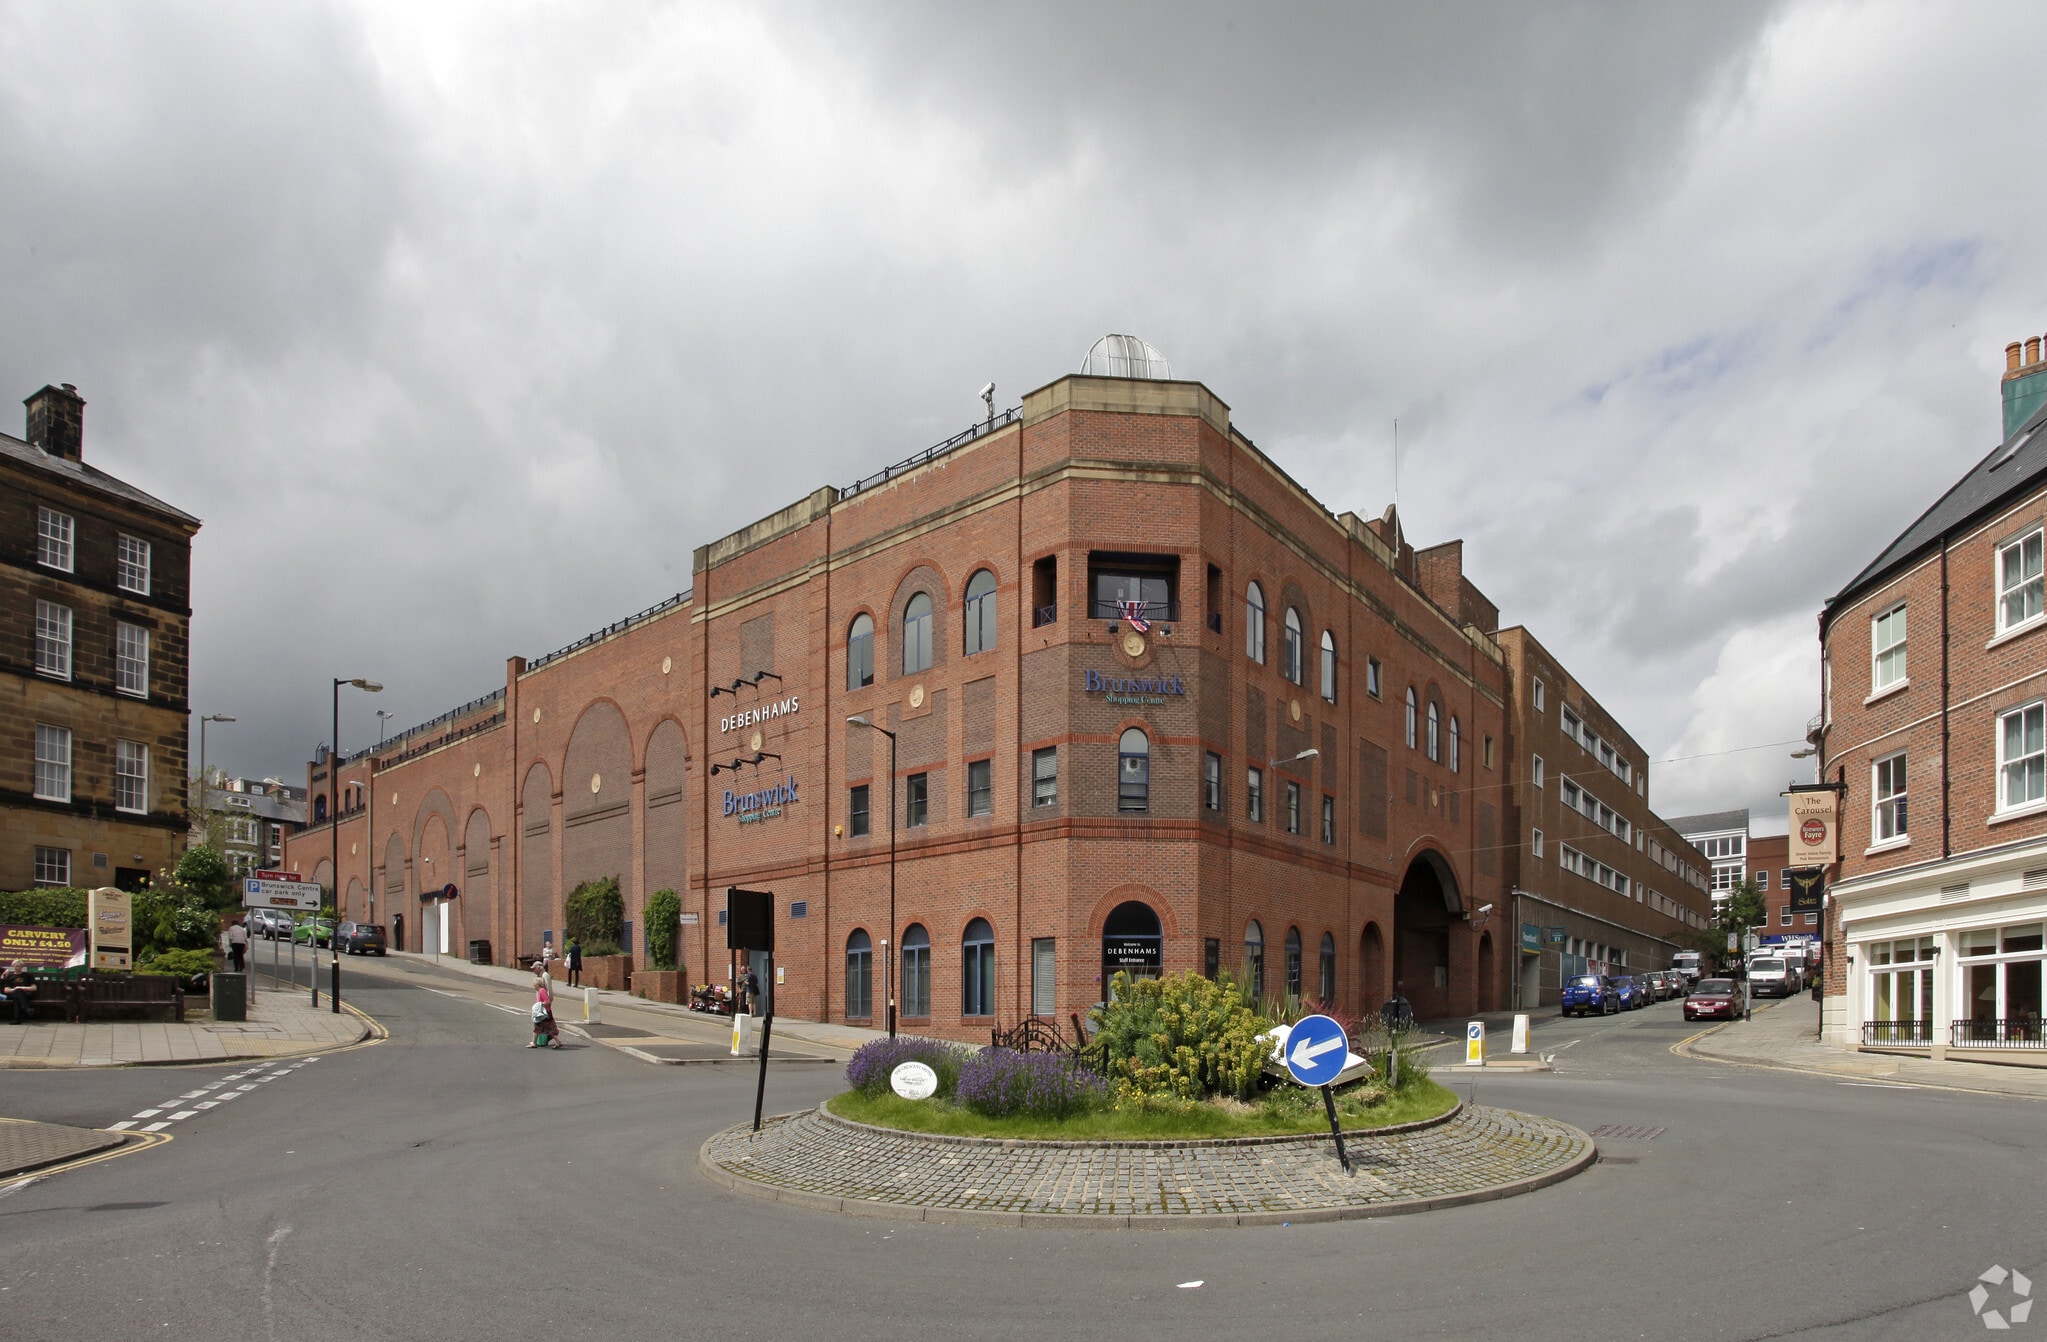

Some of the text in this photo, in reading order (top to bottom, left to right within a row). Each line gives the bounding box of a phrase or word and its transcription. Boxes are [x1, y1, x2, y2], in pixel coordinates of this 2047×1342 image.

[1085, 669, 1184, 696] Brunswick
[1106, 694, 1165, 704] Shopping Centre
[721, 696, 799, 732] DEBENHAMS
[723, 774, 799, 816] Brunswick
[1806, 797, 1821, 805] The
[1794, 806, 1832, 815] Carousel
[1804, 831, 1823, 839] Fayre
[250, 882, 258, 891] P
[261, 882, 295, 890] Brunswick
[7, 929, 67, 940] CARVERY
[1781, 934, 1814, 942] WHSmith
[2, 938, 72, 948] ONLY £4.50
